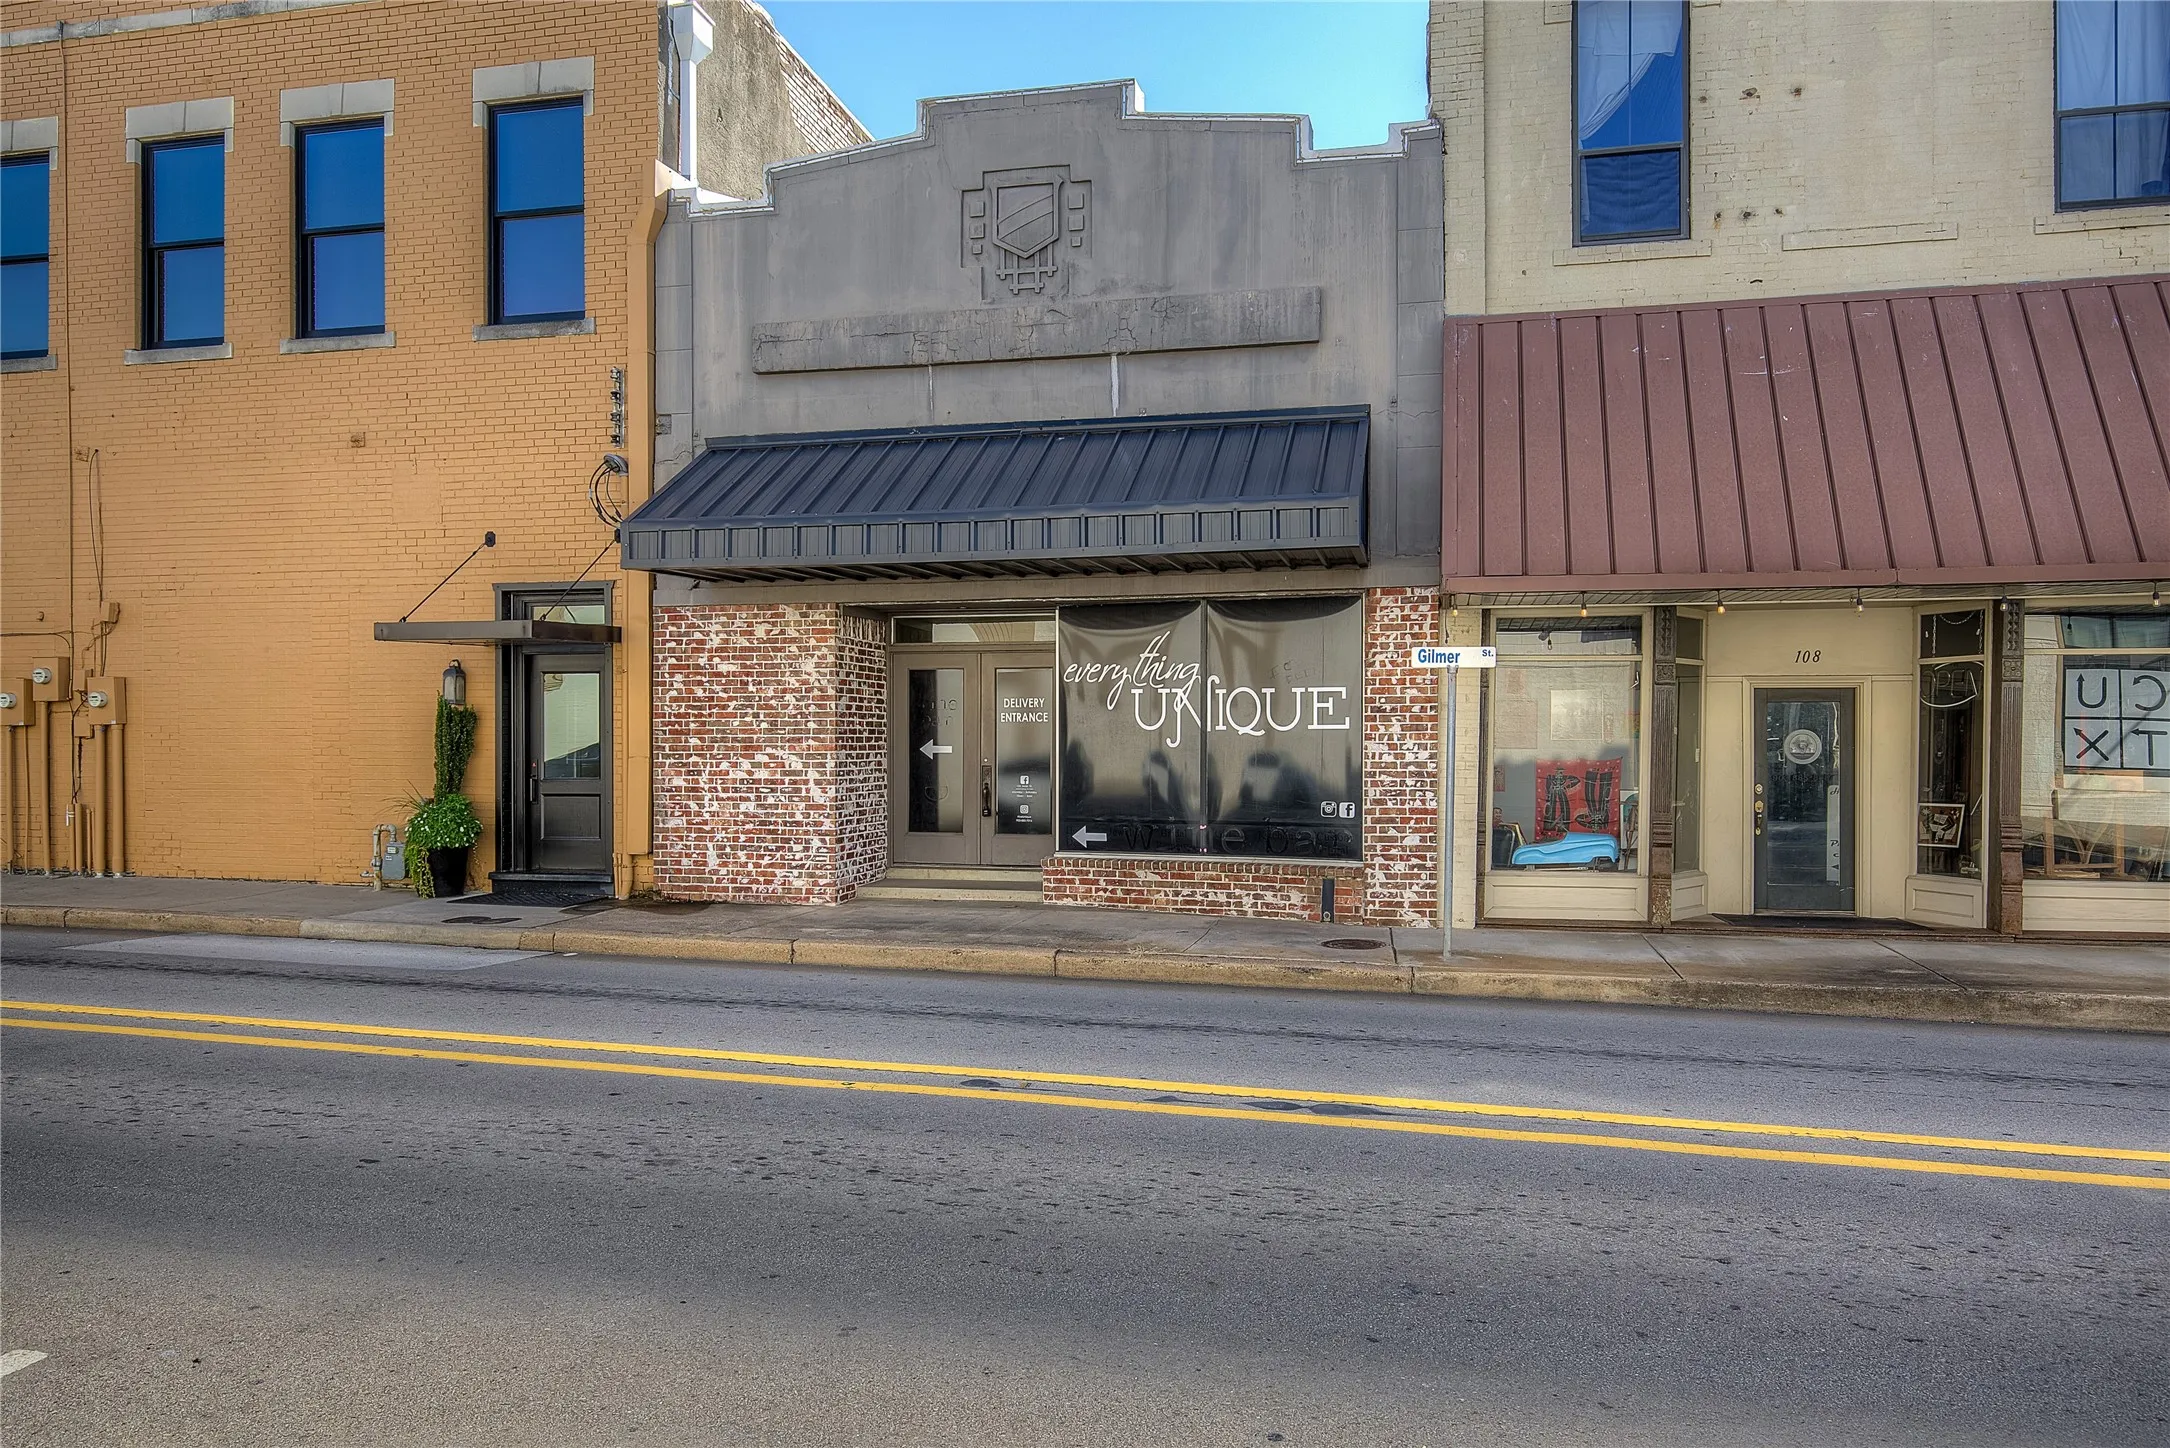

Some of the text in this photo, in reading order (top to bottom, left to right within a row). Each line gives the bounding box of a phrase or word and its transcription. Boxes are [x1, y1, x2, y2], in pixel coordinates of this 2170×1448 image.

[1418, 648, 1494, 663] Gilmer St.
[1795, 650, 1821, 663] 108
[1063, 631, 1201, 711] everything
[1003, 697, 1045, 708] DELIVERY
[1000, 712, 1049, 722] ENTRANCE
[1131, 675, 1350, 748] UNIQUE
